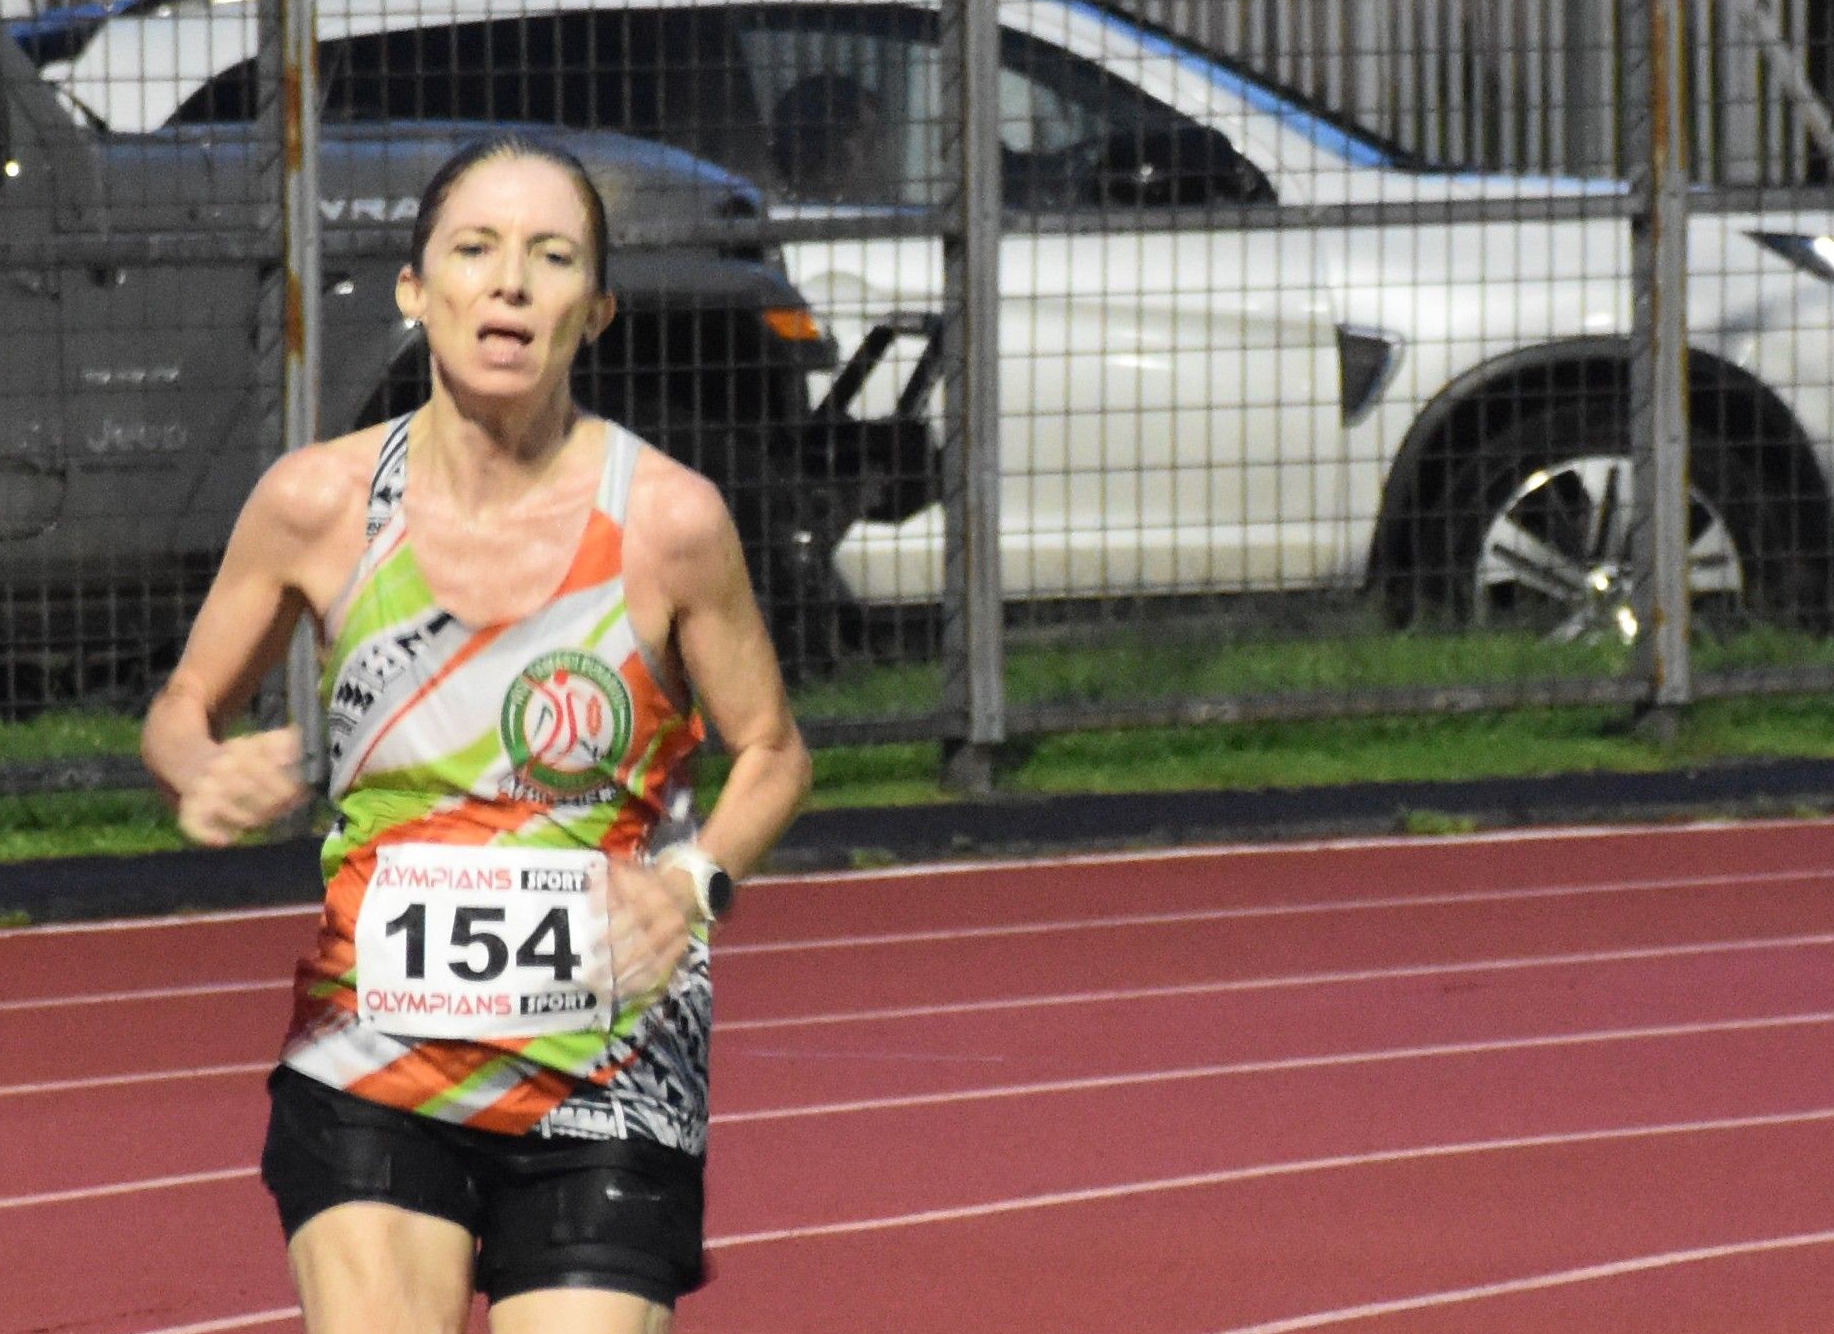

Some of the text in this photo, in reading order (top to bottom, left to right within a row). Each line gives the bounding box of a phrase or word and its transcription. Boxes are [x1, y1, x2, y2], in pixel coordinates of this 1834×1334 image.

[526, 869, 585, 892] SPORT
[385, 903, 582, 982] 154
[366, 989, 589, 1016] OLYMPIANS SPORT
